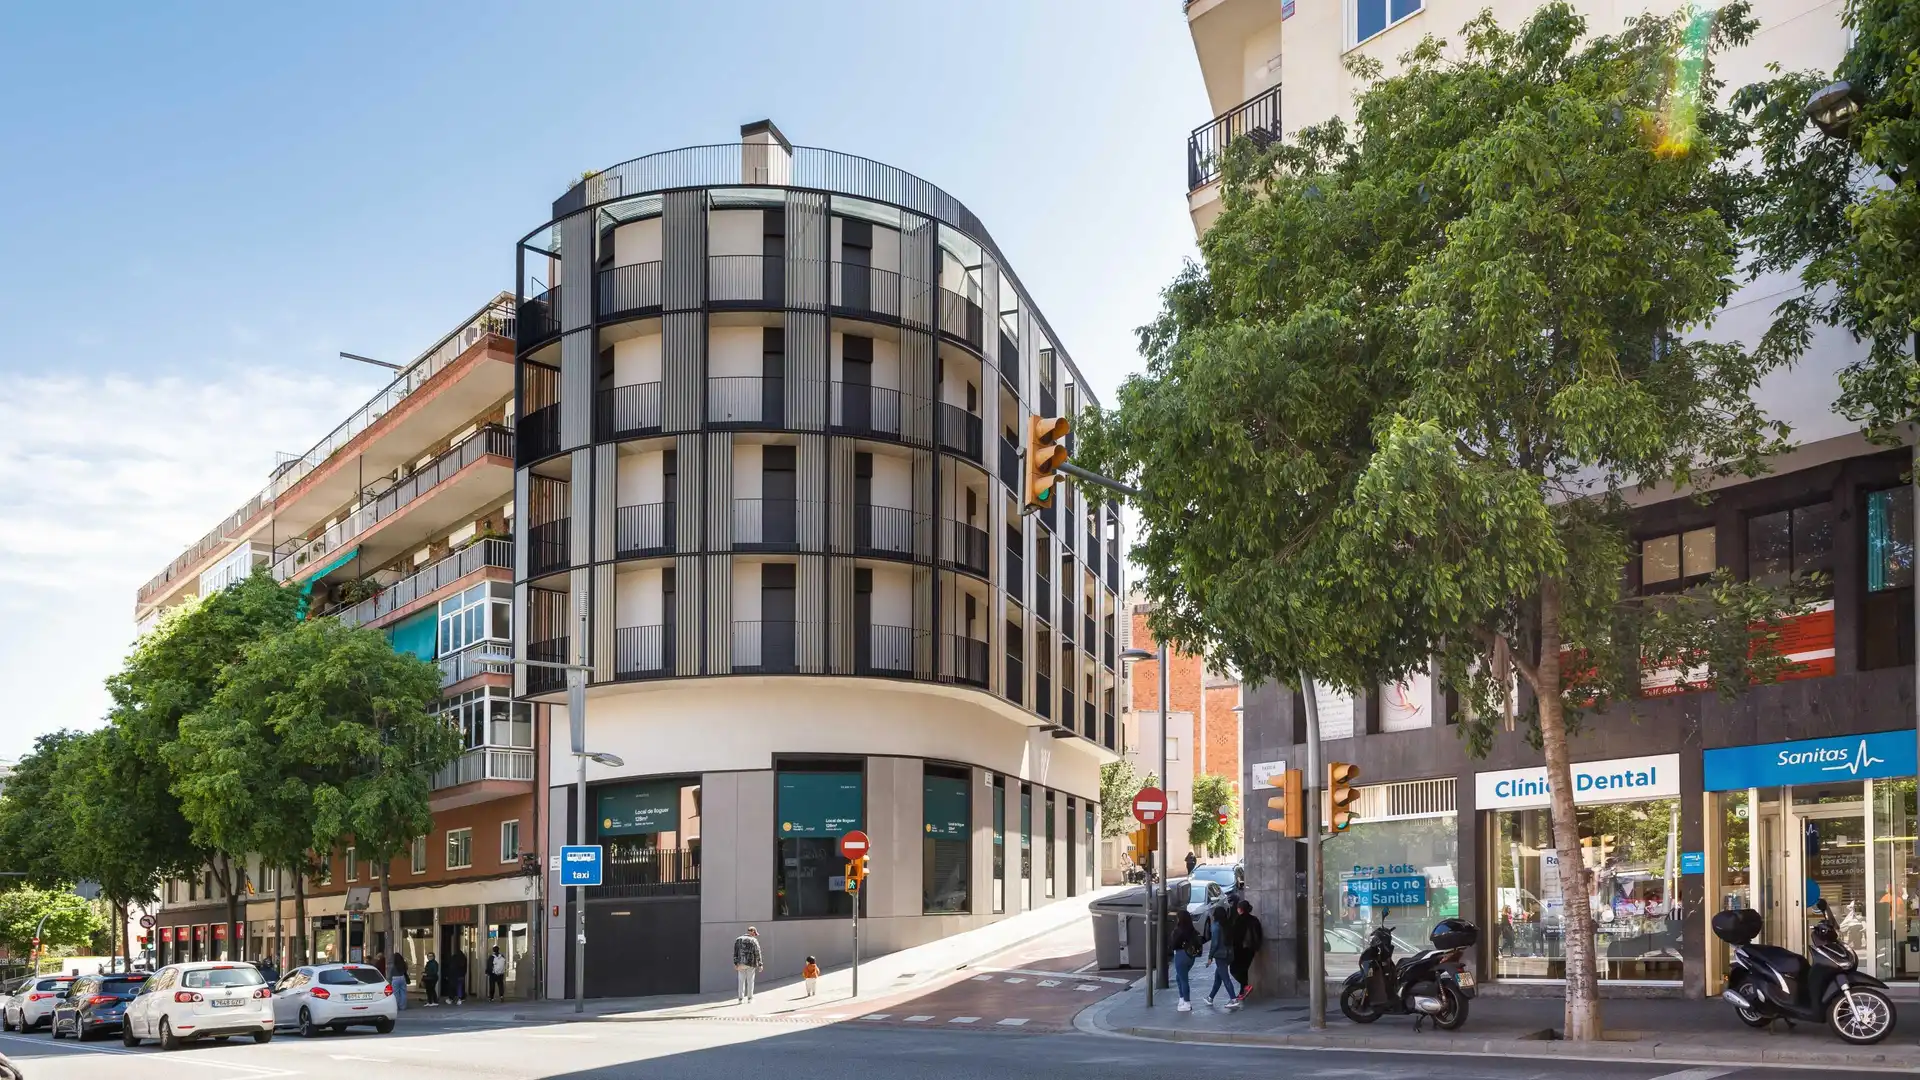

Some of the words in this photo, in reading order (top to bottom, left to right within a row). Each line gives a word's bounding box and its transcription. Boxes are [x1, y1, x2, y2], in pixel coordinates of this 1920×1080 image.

[1777, 748, 1848, 766] Sanitas
[1495, 777, 1551, 798] Clíni
[1576, 766, 1656, 791] Dental
[572, 870, 590, 879] taxi
[1353, 865, 1373, 875] Per
[1378, 866, 1385, 874] a
[1352, 880, 1387, 892] siguis
[1392, 881, 1399, 889] o
[1404, 880, 1420, 889] no
[1352, 893, 1368, 904] de
[1373, 892, 1419, 904] Sanitas
